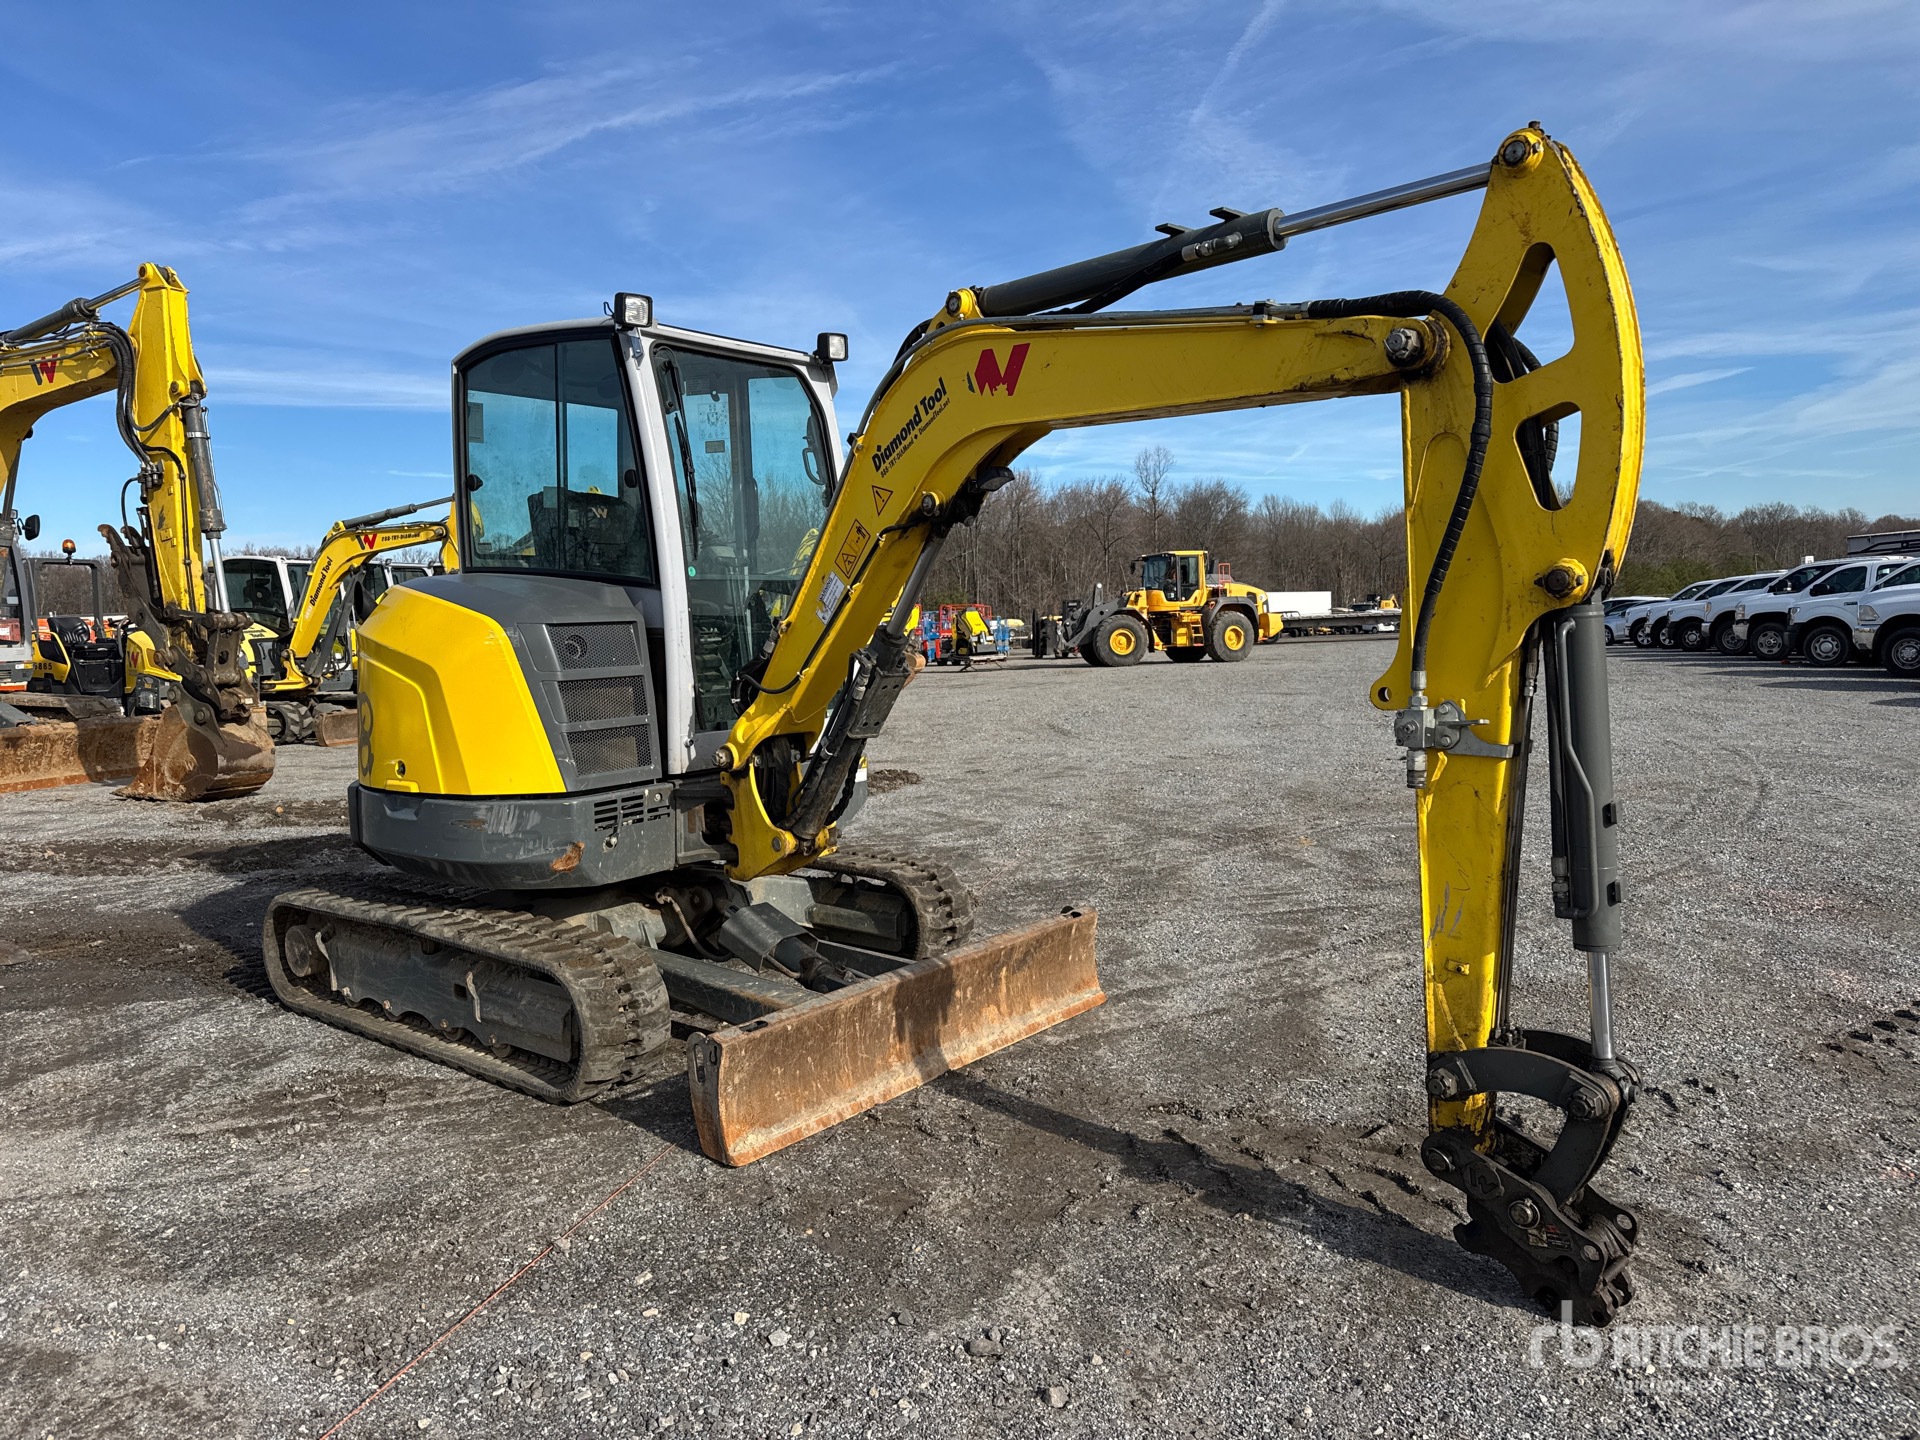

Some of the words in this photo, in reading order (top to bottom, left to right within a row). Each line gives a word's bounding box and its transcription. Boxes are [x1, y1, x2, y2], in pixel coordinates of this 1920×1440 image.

[871, 404, 923, 473] Diamond
[919, 376, 947, 416] Tool
[309, 571, 326, 607] Diamond
